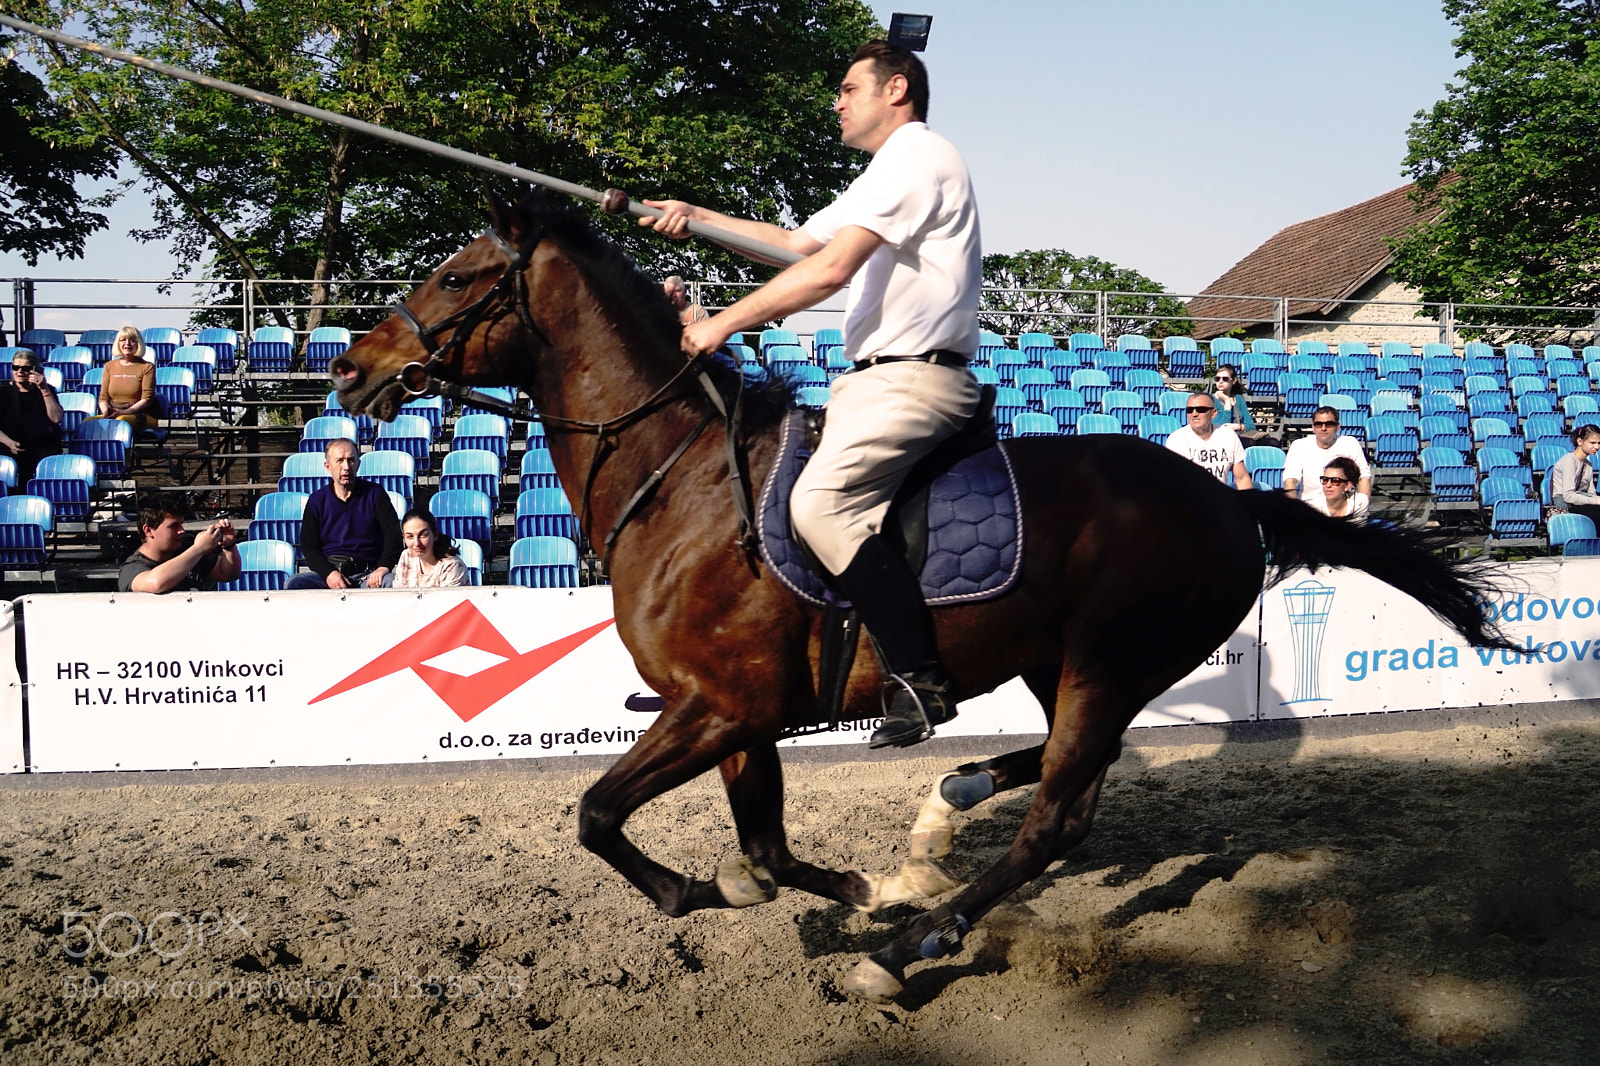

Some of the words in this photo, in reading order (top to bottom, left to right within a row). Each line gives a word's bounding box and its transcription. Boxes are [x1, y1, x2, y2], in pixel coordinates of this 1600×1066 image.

[57, 662, 91, 679] HR
[117, 661, 182, 679] 32100
[189, 659, 284, 678] Vinkovci
[1345, 639, 1459, 682] grada
[74, 687, 117, 705] H.V.
[125, 685, 238, 704] Hrvatinića
[245, 684, 266, 702] 11
[439, 732, 501, 749] d.o.o.
[508, 733, 532, 746] za
